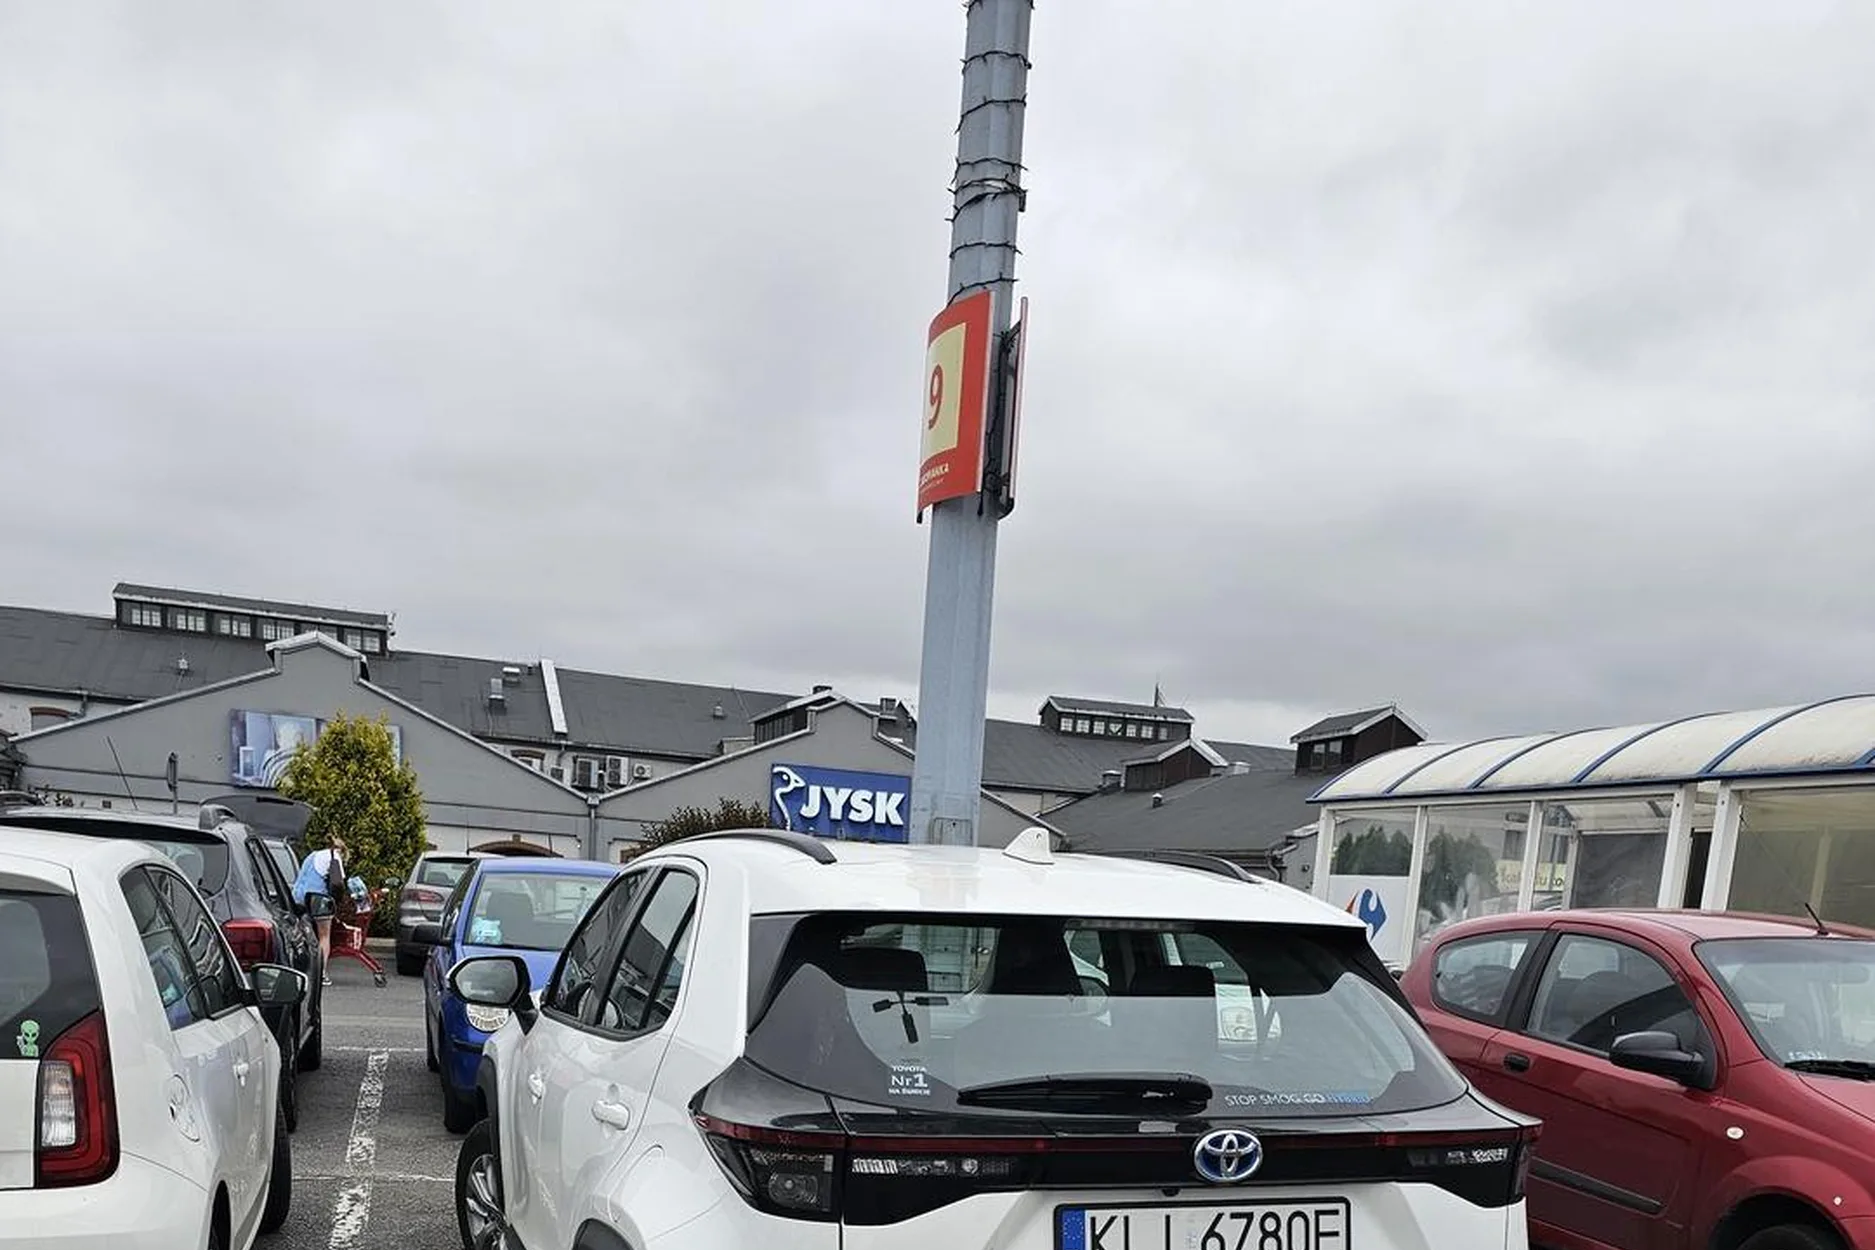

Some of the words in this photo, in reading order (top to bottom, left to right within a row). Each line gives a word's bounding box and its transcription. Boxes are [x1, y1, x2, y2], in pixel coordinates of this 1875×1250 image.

[928, 363, 943, 429] 9
[799, 785, 905, 826] JYSK
[1224, 1093, 1257, 1107] STOP
[1259, 1093, 1303, 1105] SMOG
